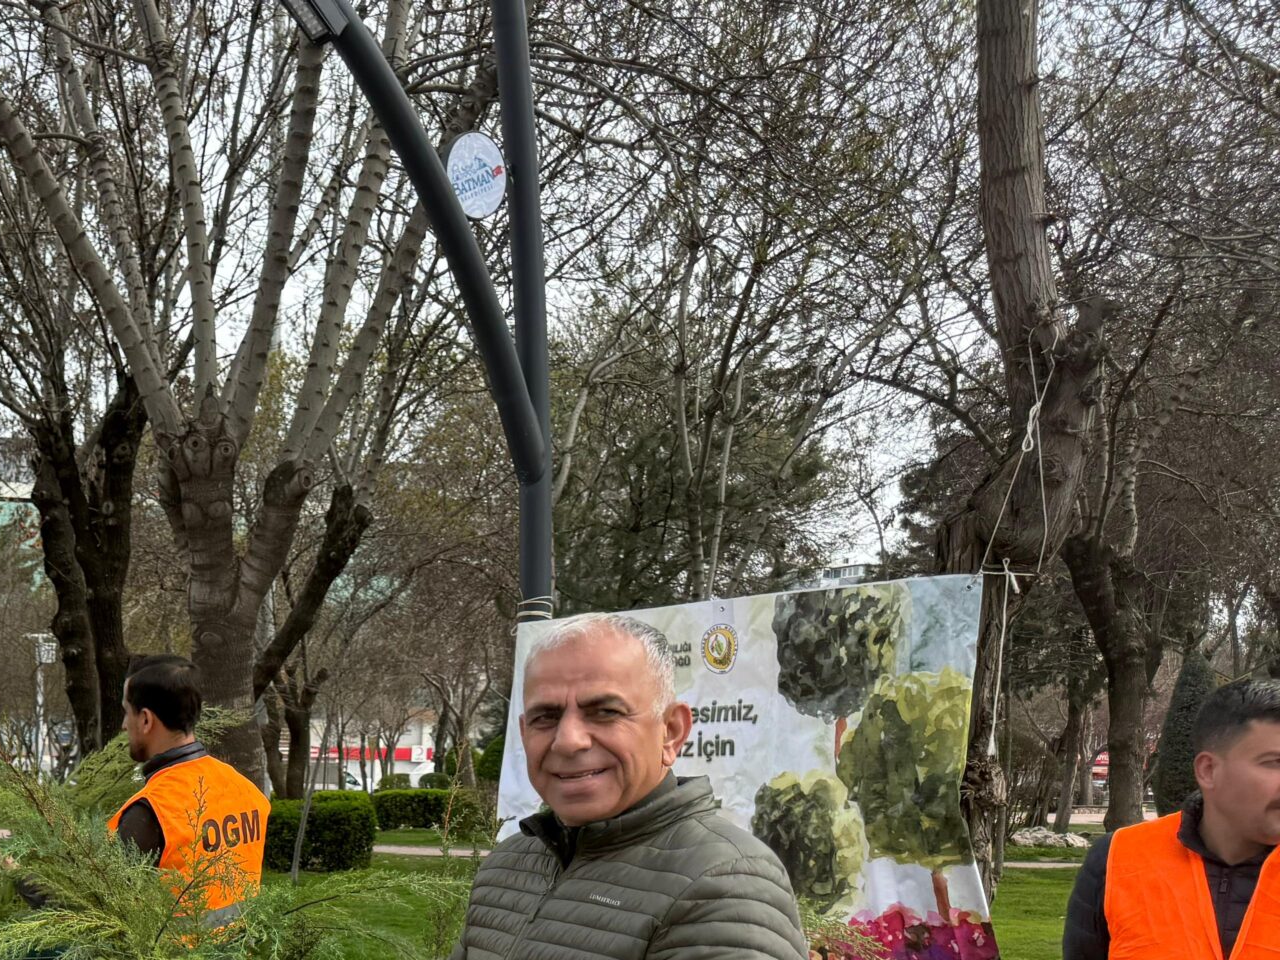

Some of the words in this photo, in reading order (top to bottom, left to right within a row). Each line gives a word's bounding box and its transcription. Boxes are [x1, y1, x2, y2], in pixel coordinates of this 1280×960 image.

[452, 169, 496, 196] BATMAN
[698, 731, 735, 762] İçin
[202, 809, 260, 852] OGM
